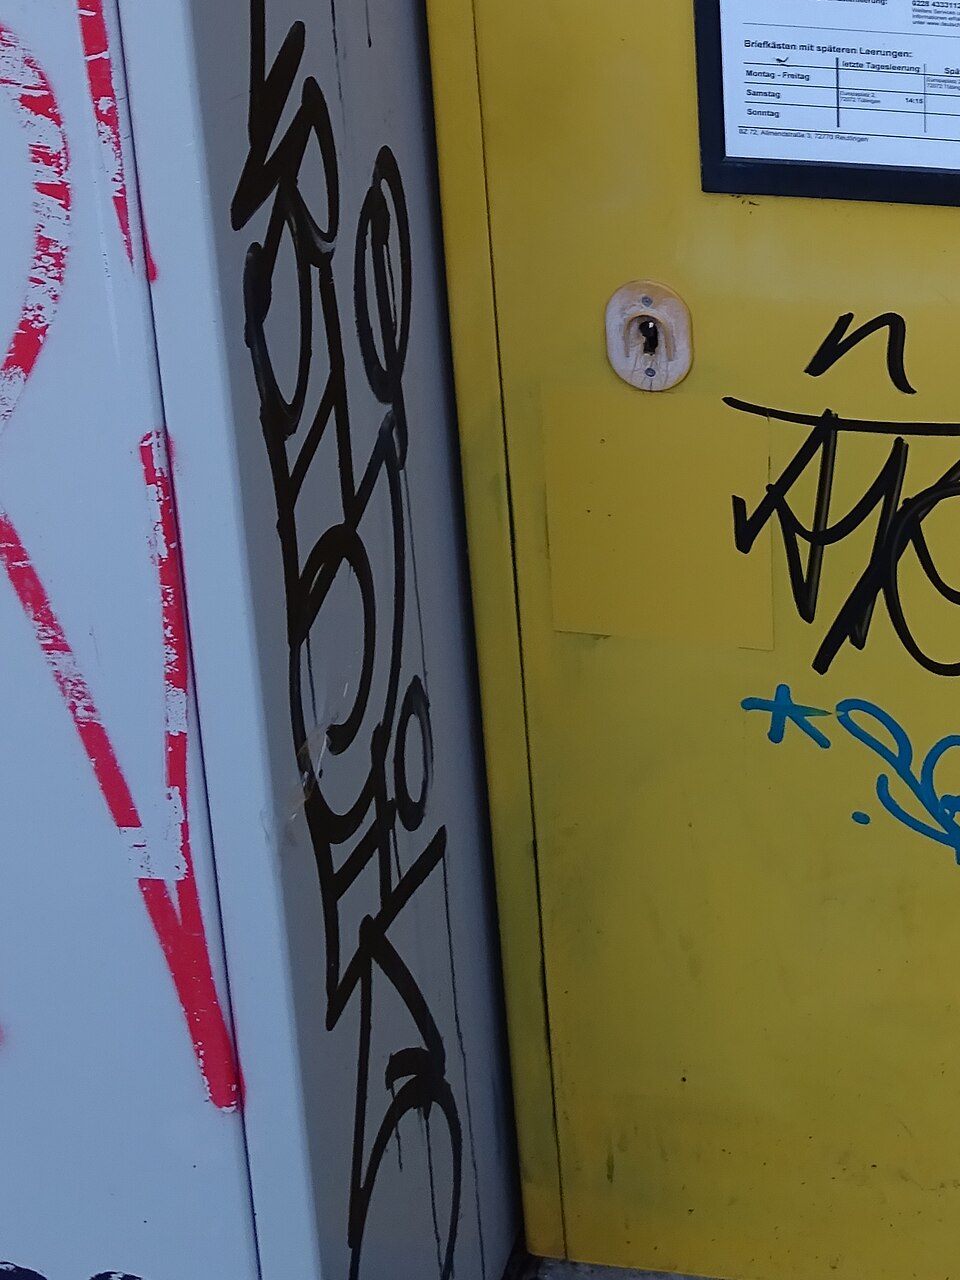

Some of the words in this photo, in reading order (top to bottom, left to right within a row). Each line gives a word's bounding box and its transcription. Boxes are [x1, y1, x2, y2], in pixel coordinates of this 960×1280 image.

[744, 40, 797, 50] Briefkästen
[800, 43, 814, 52] mit
[816, 45, 857, 55] späteren
[859, 47, 912, 58] Leerungen:
[842, 60, 864, 68] letzte
[865, 61, 921, 73] Tagesleerung
[746, 70, 775, 80] Montag
[782, 72, 810, 81] Freitag
[746, 89, 781, 99] Samstag
[746, 108, 780, 118] Sonntag
